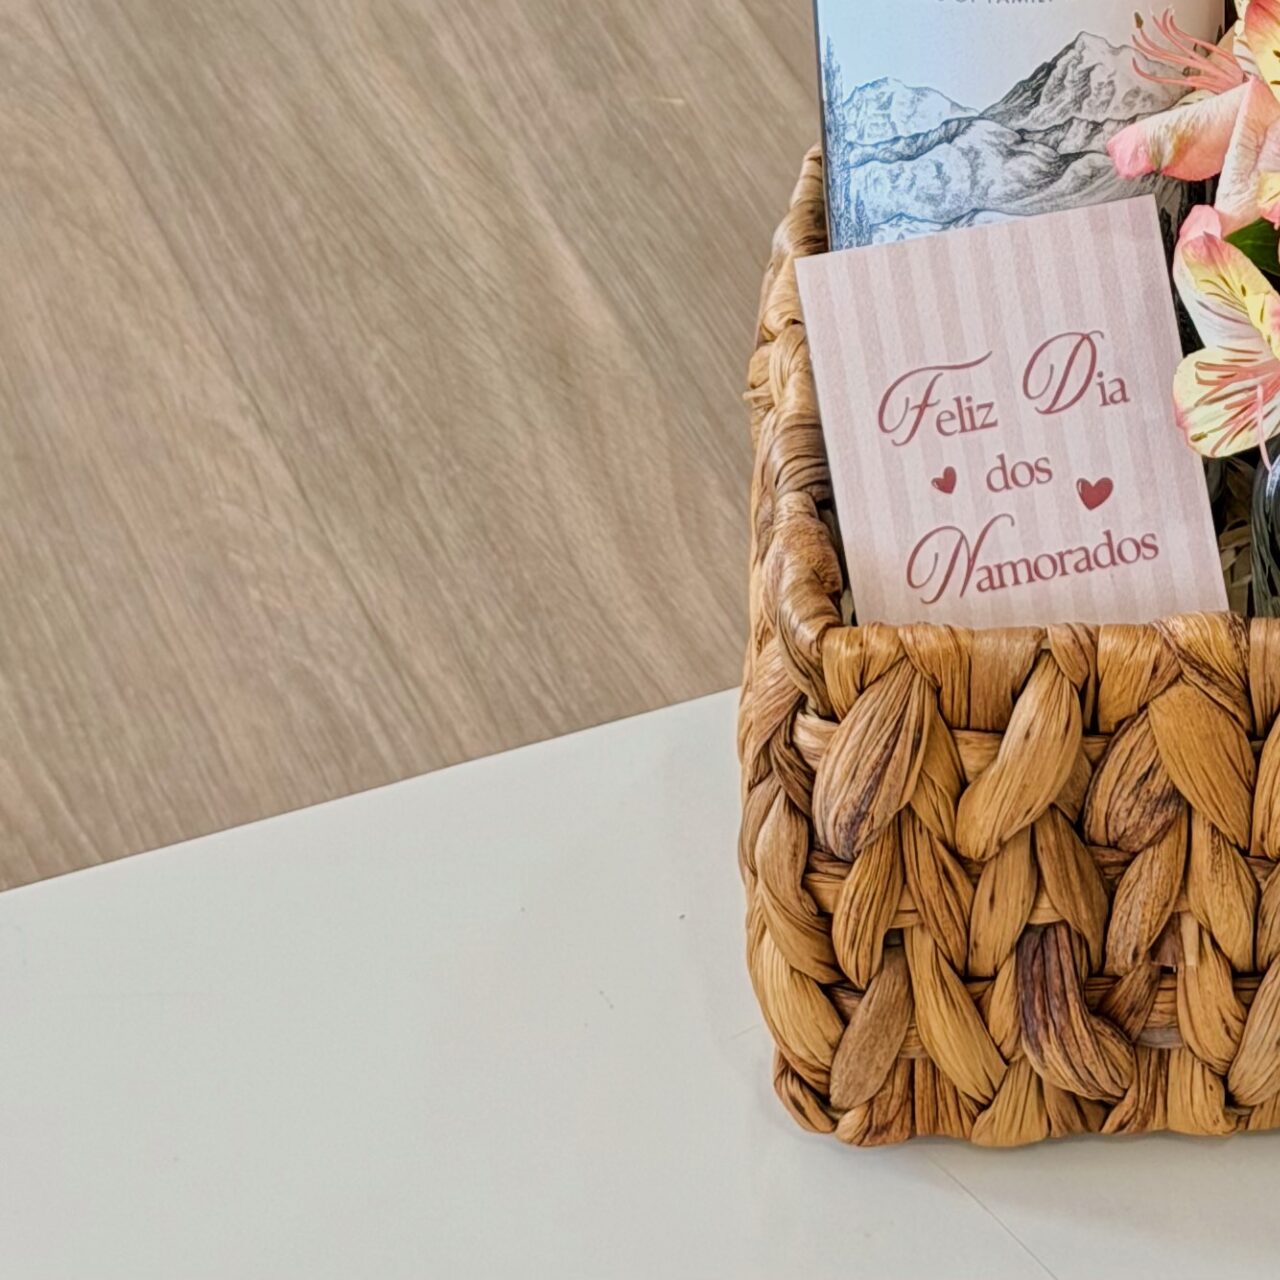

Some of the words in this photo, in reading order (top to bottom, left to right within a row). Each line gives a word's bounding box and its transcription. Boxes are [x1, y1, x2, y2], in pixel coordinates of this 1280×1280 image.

[877, 350, 999, 447] Feliz
[1021, 329, 1131, 415] Dia
[985, 453, 1053, 493] dos
[905, 513, 1160, 606] Namorados
